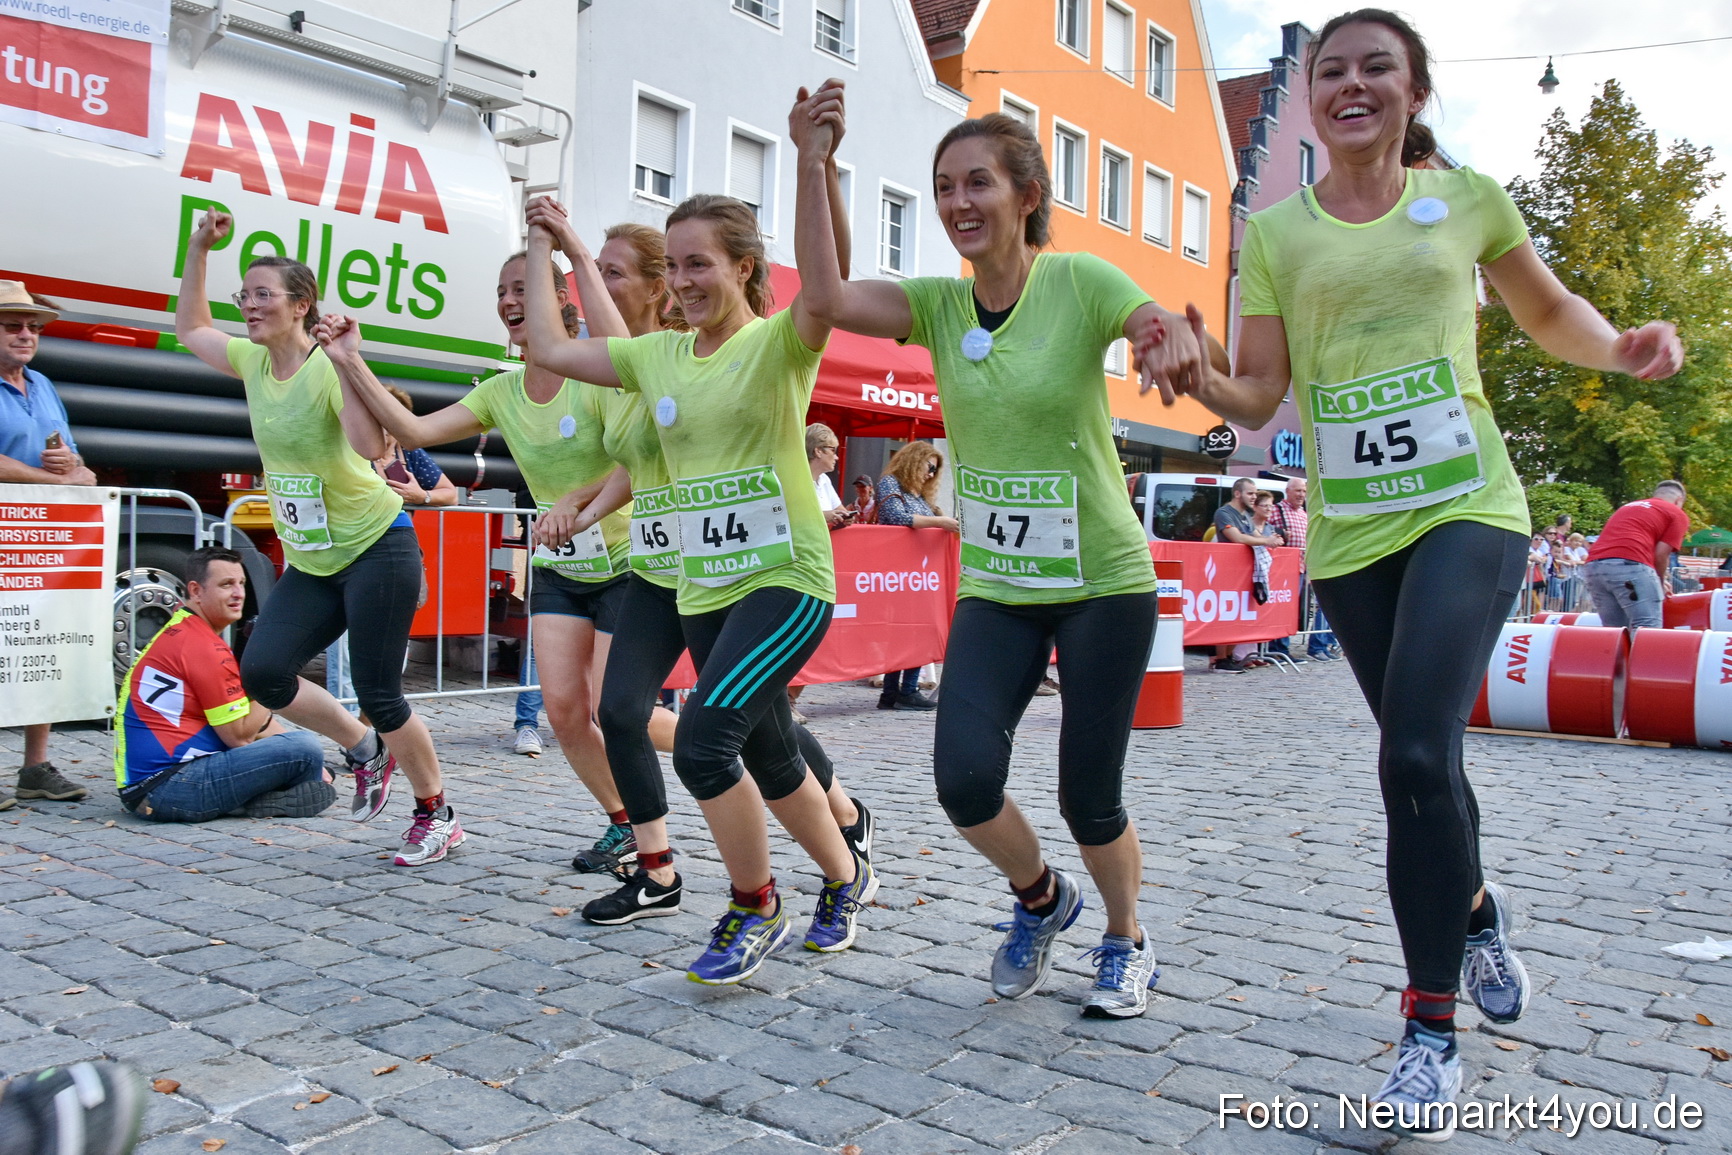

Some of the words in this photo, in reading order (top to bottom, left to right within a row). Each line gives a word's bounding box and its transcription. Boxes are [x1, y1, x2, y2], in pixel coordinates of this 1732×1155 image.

[2, 45, 110, 116] tung
[173, 194, 447, 320] Pellets
[1317, 365, 1446, 419] BOCK
[1448, 409, 1461, 418] E6
[1354, 419, 1418, 467] 45
[268, 476, 315, 496] OCK
[677, 471, 771, 508] BOCK
[961, 468, 1064, 503] BOCK
[1365, 473, 1425, 498] SUSI
[279, 500, 299, 525] 48
[632, 488, 678, 516] OCK
[702, 512, 749, 548] 44
[987, 511, 1030, 549] 47
[1062, 515, 1073, 524] E6
[641, 521, 670, 549] 46
[543, 561, 593, 571] CARMEN
[645, 553, 680, 568] SILVIA
[703, 553, 762, 575] NADJA
[986, 556, 1041, 574] JULIA
[855, 561, 940, 593] energie
[0, 604, 30, 617] mbH
[33, 619, 41, 631] 8
[4, 632, 94, 647] Neumarkt-Pölling
[22, 654, 57, 668] 2307-0
[22, 669, 62, 683] 2307-70
[146, 674, 178, 704] 7
